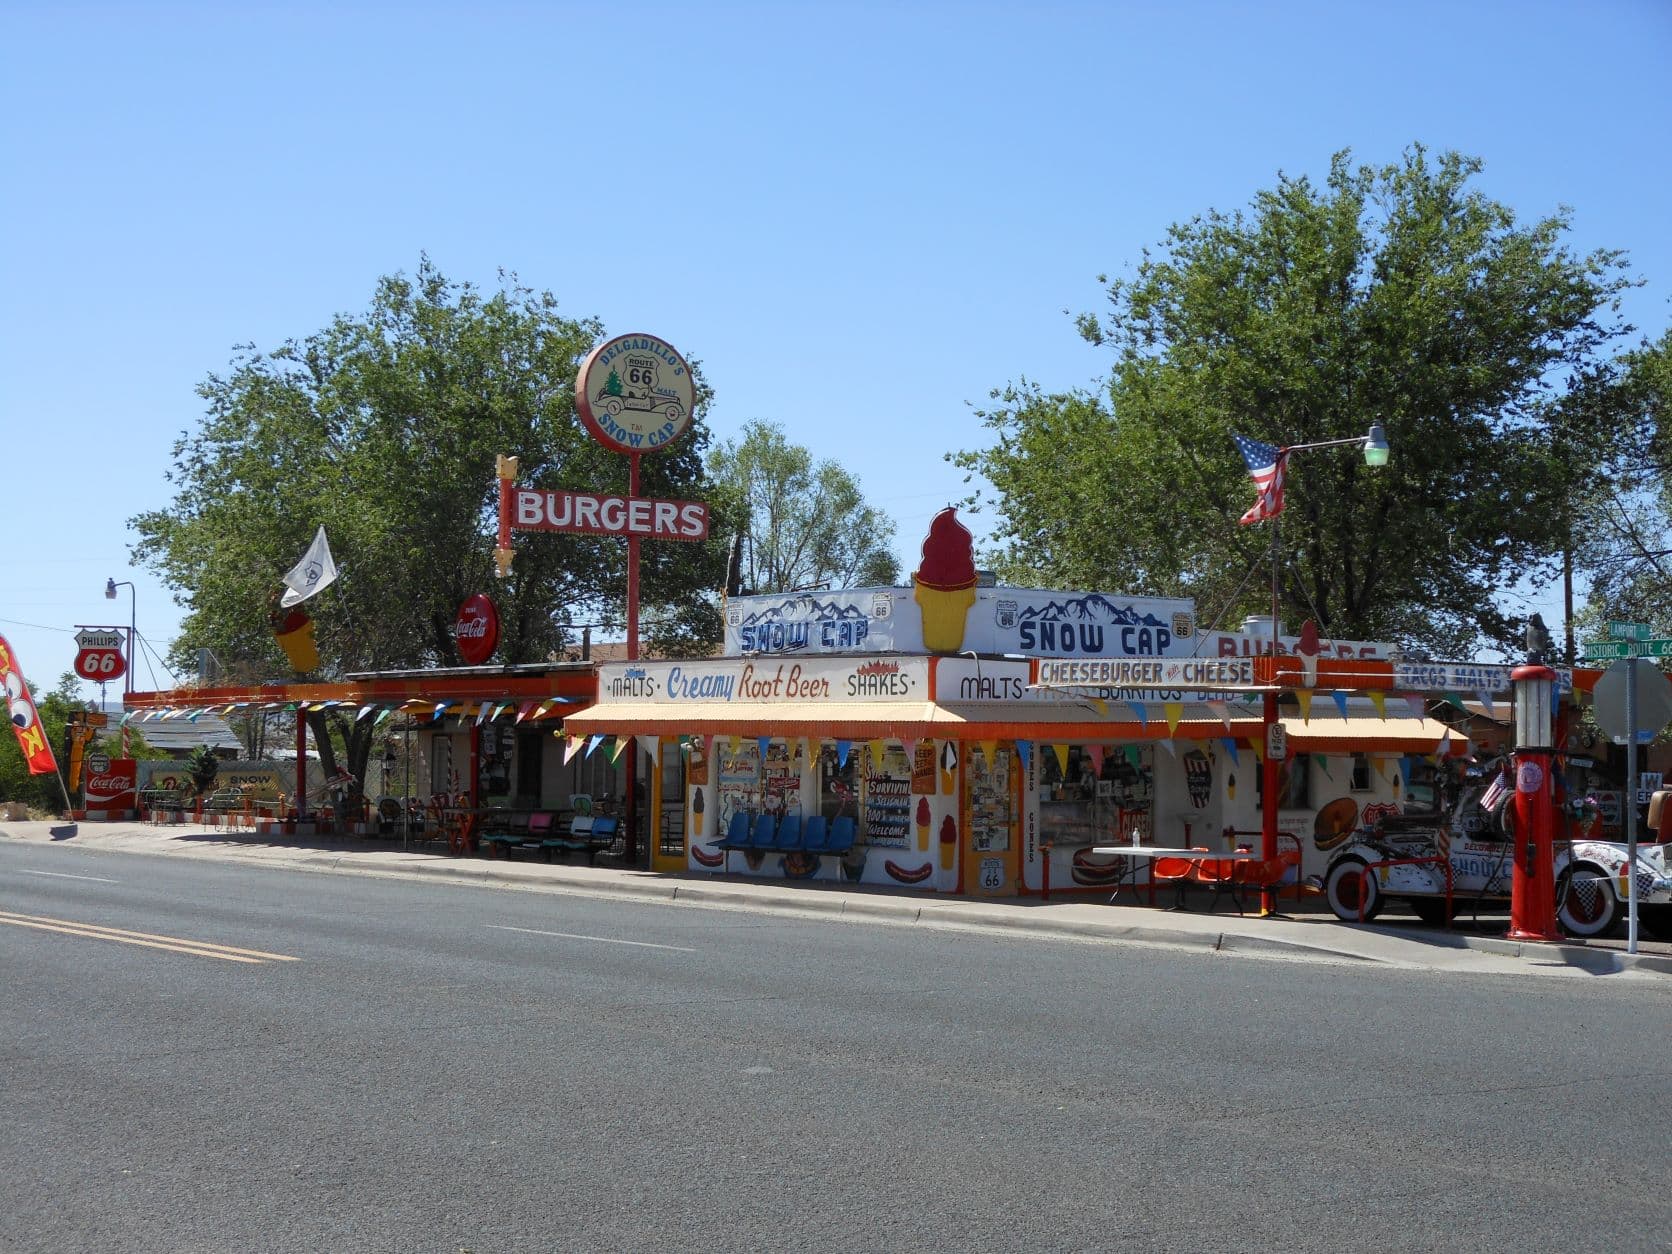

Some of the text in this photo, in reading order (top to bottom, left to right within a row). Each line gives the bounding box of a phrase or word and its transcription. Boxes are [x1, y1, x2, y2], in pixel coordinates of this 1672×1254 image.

[600, 339, 684, 376] DELGADILLO'S
[628, 358, 654, 367] ROUTE
[629, 368, 653, 385] 66
[599, 413, 676, 448] SNOW CAP
[518, 491, 705, 536] BURGERS
[82, 636, 119, 646] PHILLIPS
[741, 619, 868, 651] SNOW CAP
[1020, 621, 1171, 656] SNOW CAP
[1176, 626, 1188, 636] 66
[1585, 644, 1620, 657] HISTORIC
[1628, 642, 1654, 656] ROUTE
[83, 653, 116, 673] 66
[1041, 662, 1163, 684] CHEESEBURGER
[1183, 661, 1252, 684] CHEESE
[612, 664, 909, 701] MALTS Creamy Root Beer SHAKES
[960, 677, 1022, 700] MALTS
[1402, 666, 1447, 687] TACOS
[1455, 668, 1501, 689] MALTS
[230, 775, 271, 784] SNOW
[985, 874, 1000, 887] 66
